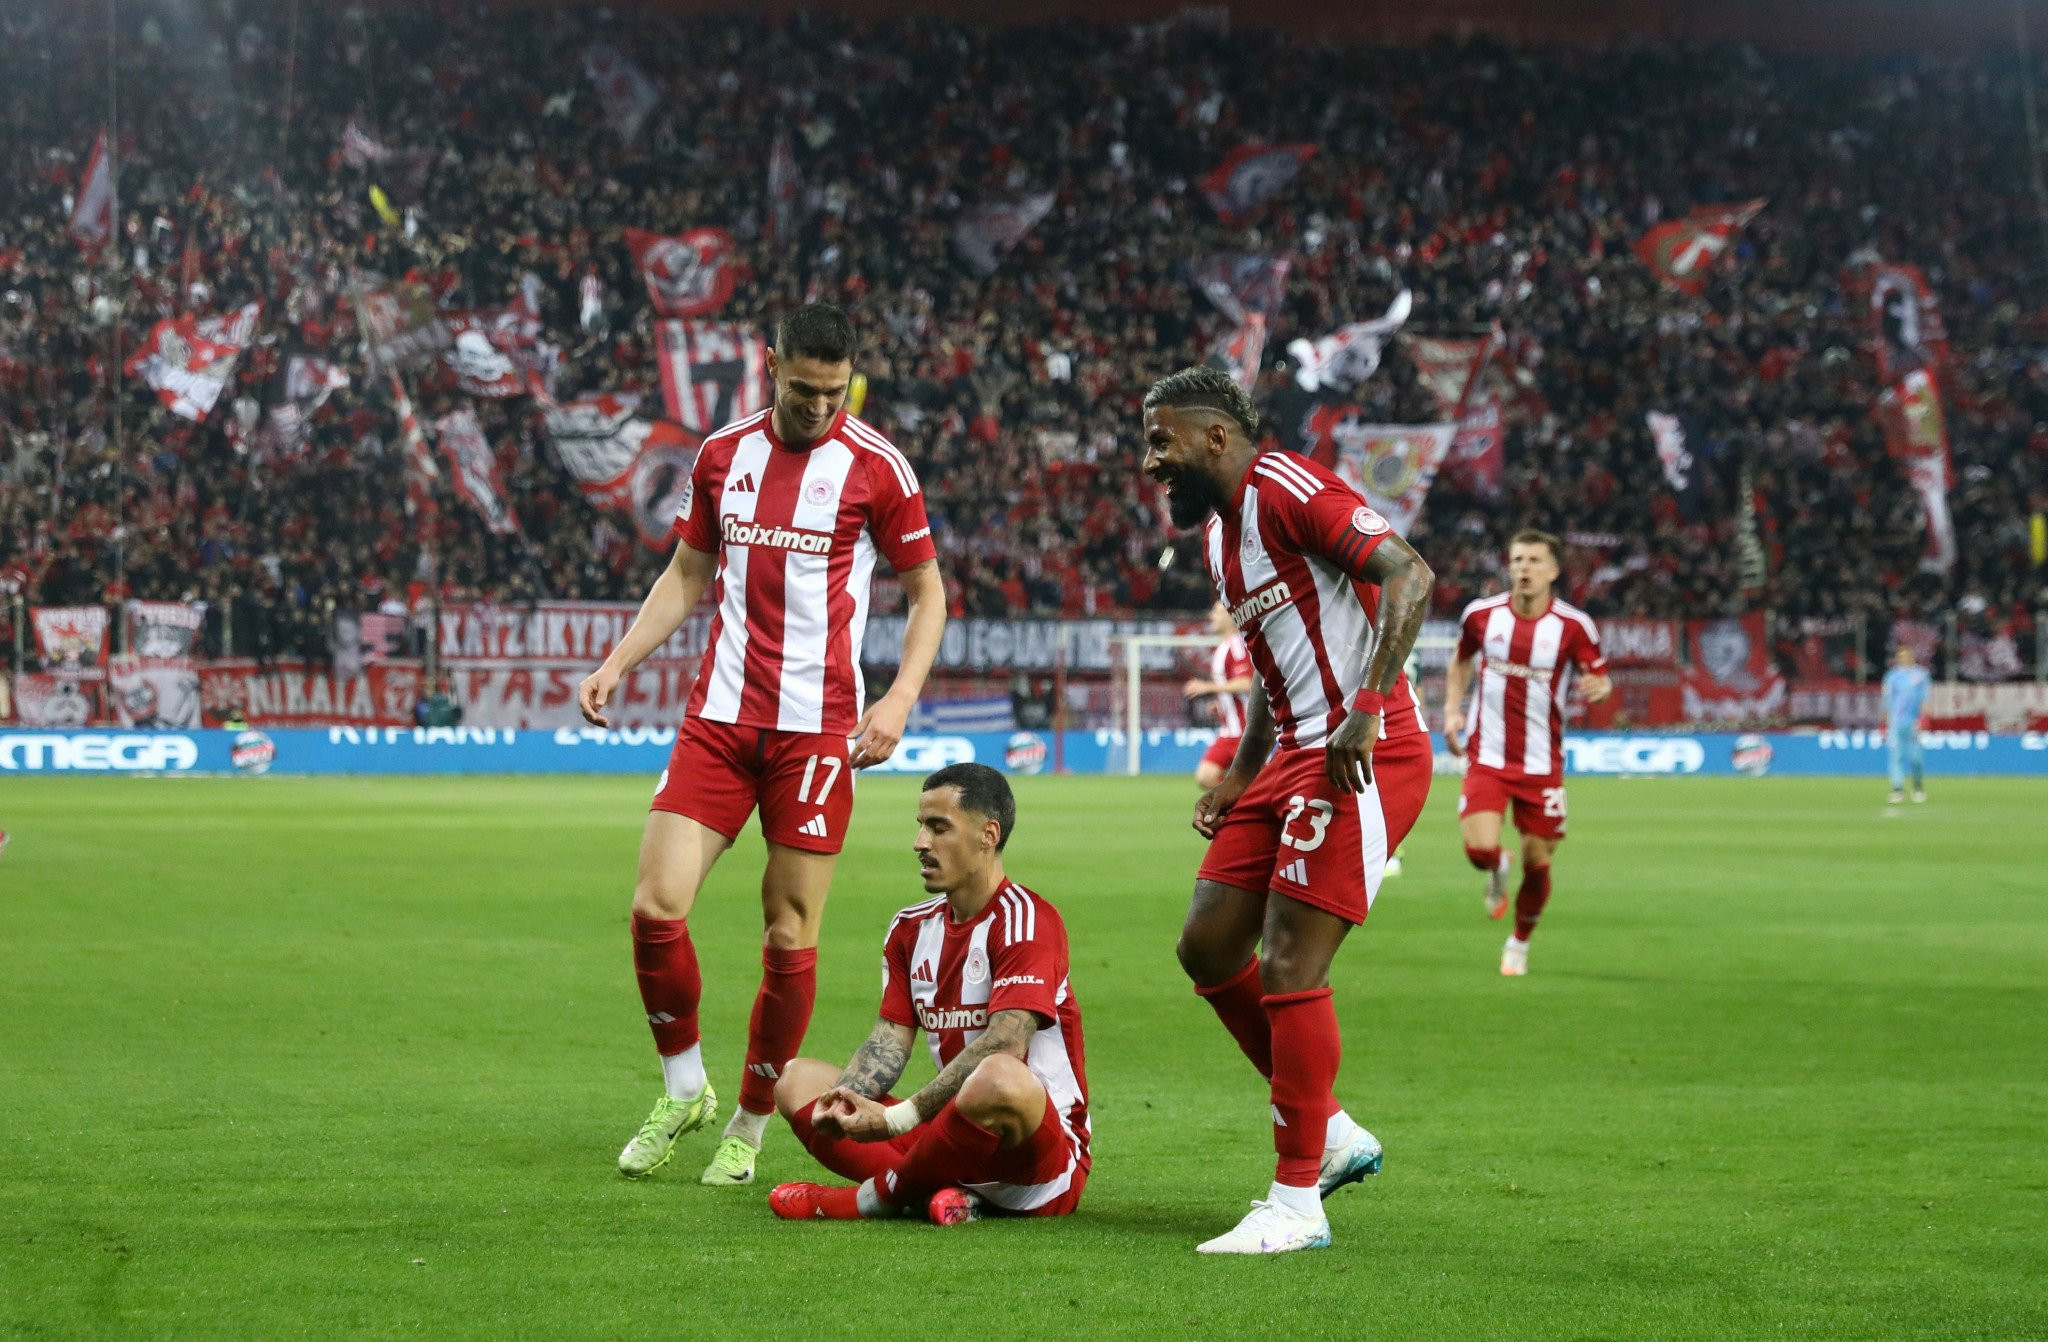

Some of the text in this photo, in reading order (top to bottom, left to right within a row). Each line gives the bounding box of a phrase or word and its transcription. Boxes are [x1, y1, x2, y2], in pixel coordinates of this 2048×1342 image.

[722, 516, 833, 552] Stoiximan
[245, 672, 376, 718] NIKAIA
[0, 734, 199, 770] MEGA
[798, 754, 842, 806] 17
[1280, 795, 1334, 852] 23
